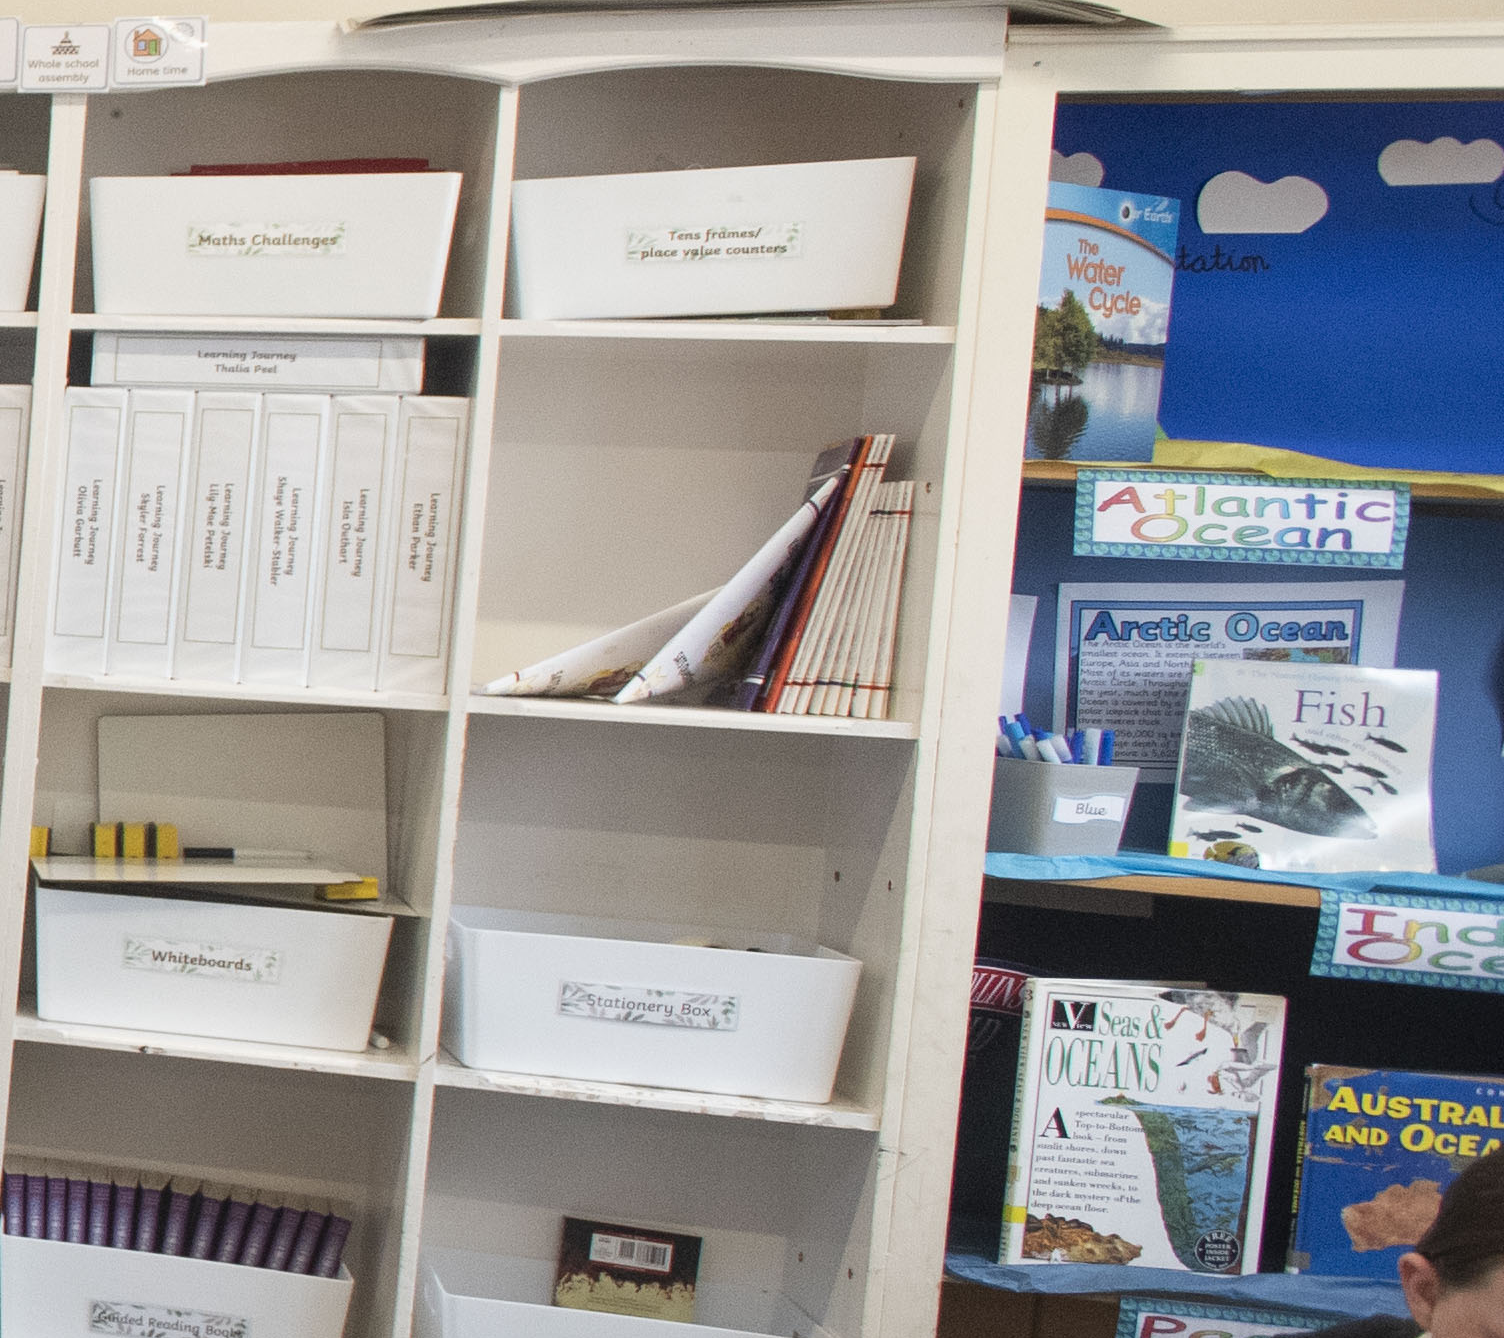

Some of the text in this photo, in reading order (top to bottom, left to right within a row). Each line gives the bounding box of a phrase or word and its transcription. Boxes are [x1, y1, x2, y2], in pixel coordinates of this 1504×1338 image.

[28, 59, 99, 70] Whole school
[127, 65, 187, 76] Home time
[39, 73, 89, 84] assembly
[198, 232, 339, 250] Maths Challenges
[668, 227, 763, 243] Tens frames/
[641, 243, 787, 260] place value counters
[1078, 239, 1099, 256] The
[1067, 253, 1126, 286] Water
[1089, 286, 1141, 318] Cycle
[1096, 484, 1393, 524] Atlantic
[1130, 512, 1353, 551] Ocean
[1085, 611, 1349, 642] Arctic Ocean
[1291, 688, 1388, 728] Fish
[1076, 803, 1106, 815] Blue
[152, 950, 252, 971] Whiteboards
[587, 994, 711, 1017] Stationery Box
[1099, 1000, 1165, 1040] Seas &
[1045, 1036, 1162, 1092] OCEANS
